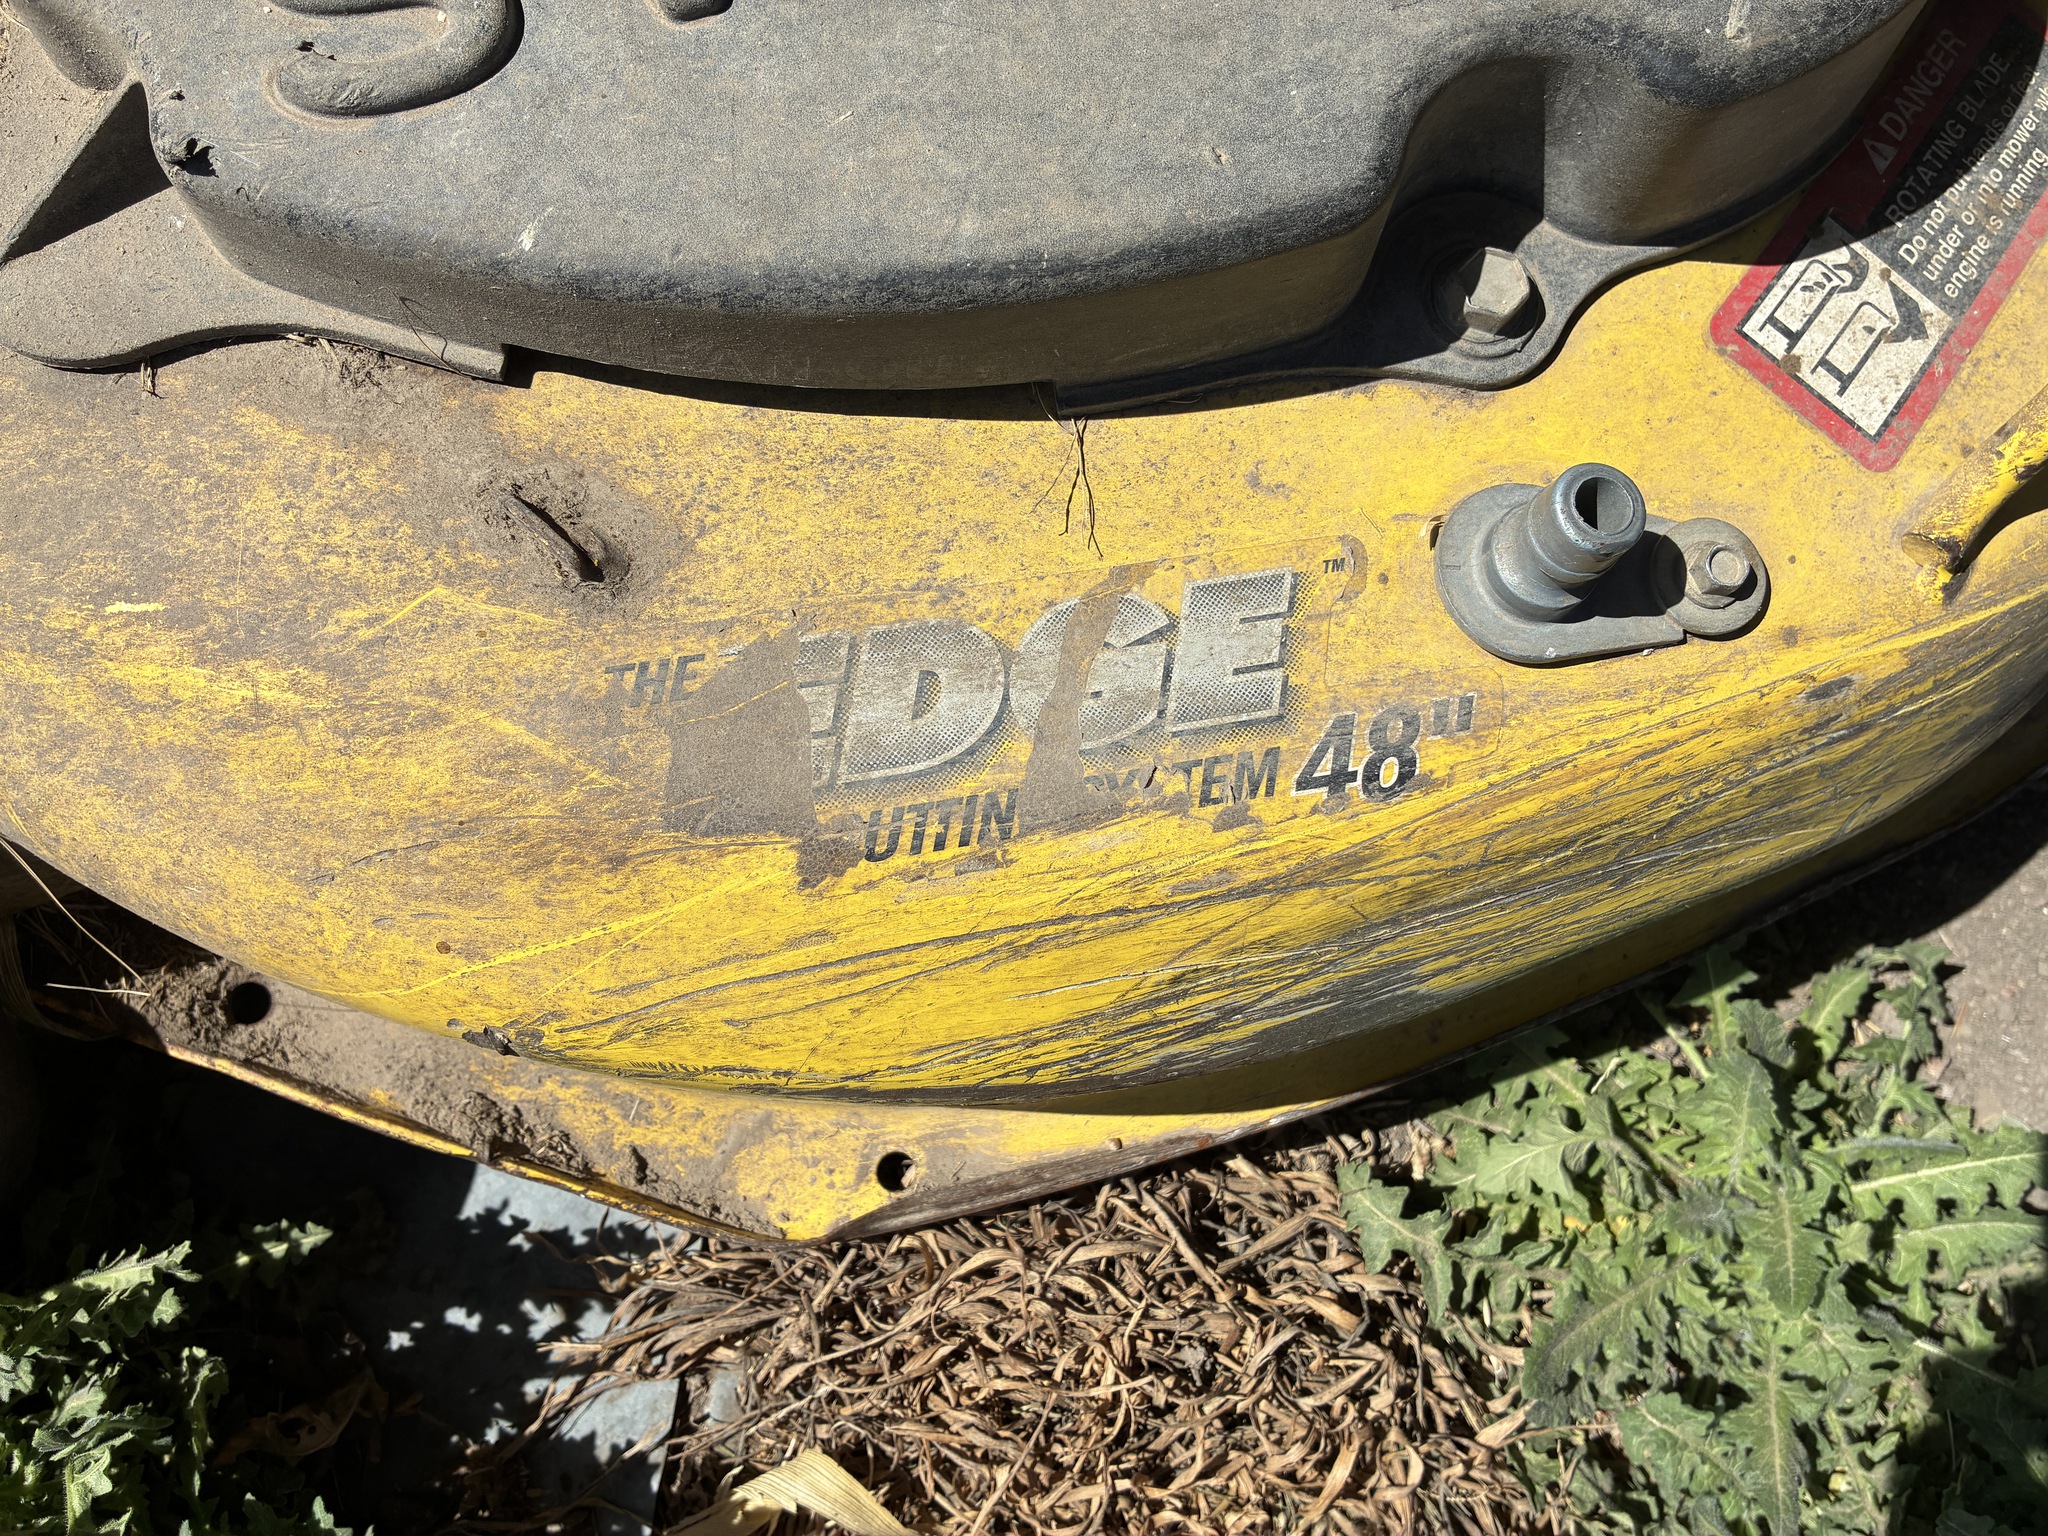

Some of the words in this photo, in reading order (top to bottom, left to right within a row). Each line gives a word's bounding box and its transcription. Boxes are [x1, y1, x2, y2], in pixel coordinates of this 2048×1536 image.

[1878, 28, 1967, 141] DANGER
[1885, 119, 1967, 228] ROTATING
[1956, 52, 2010, 122] BLADE
[1898, 235, 1927, 265] Do
[1922, 200, 1950, 236] not
[1944, 168, 1972, 206] put
[1962, 118, 2005, 171] hands
[2000, 94, 2018, 119] or
[2010, 65, 2040, 99] feet
[1922, 224, 1965, 281] under
[1961, 202, 1977, 225] or
[1971, 168, 2003, 204] into
[1998, 110, 2040, 168] mower
[2034, 85, 2048, 112] wh
[1944, 235, 1990, 298] engine
[1986, 215, 2003, 235] is
[2001, 147, 2048, 216] running
[605, 653, 706, 708] THE
[860, 788, 1020, 863] UTTIN
[1083, 746, 1281, 808] YTEM
[1290, 692, 1477, 801] 48"
